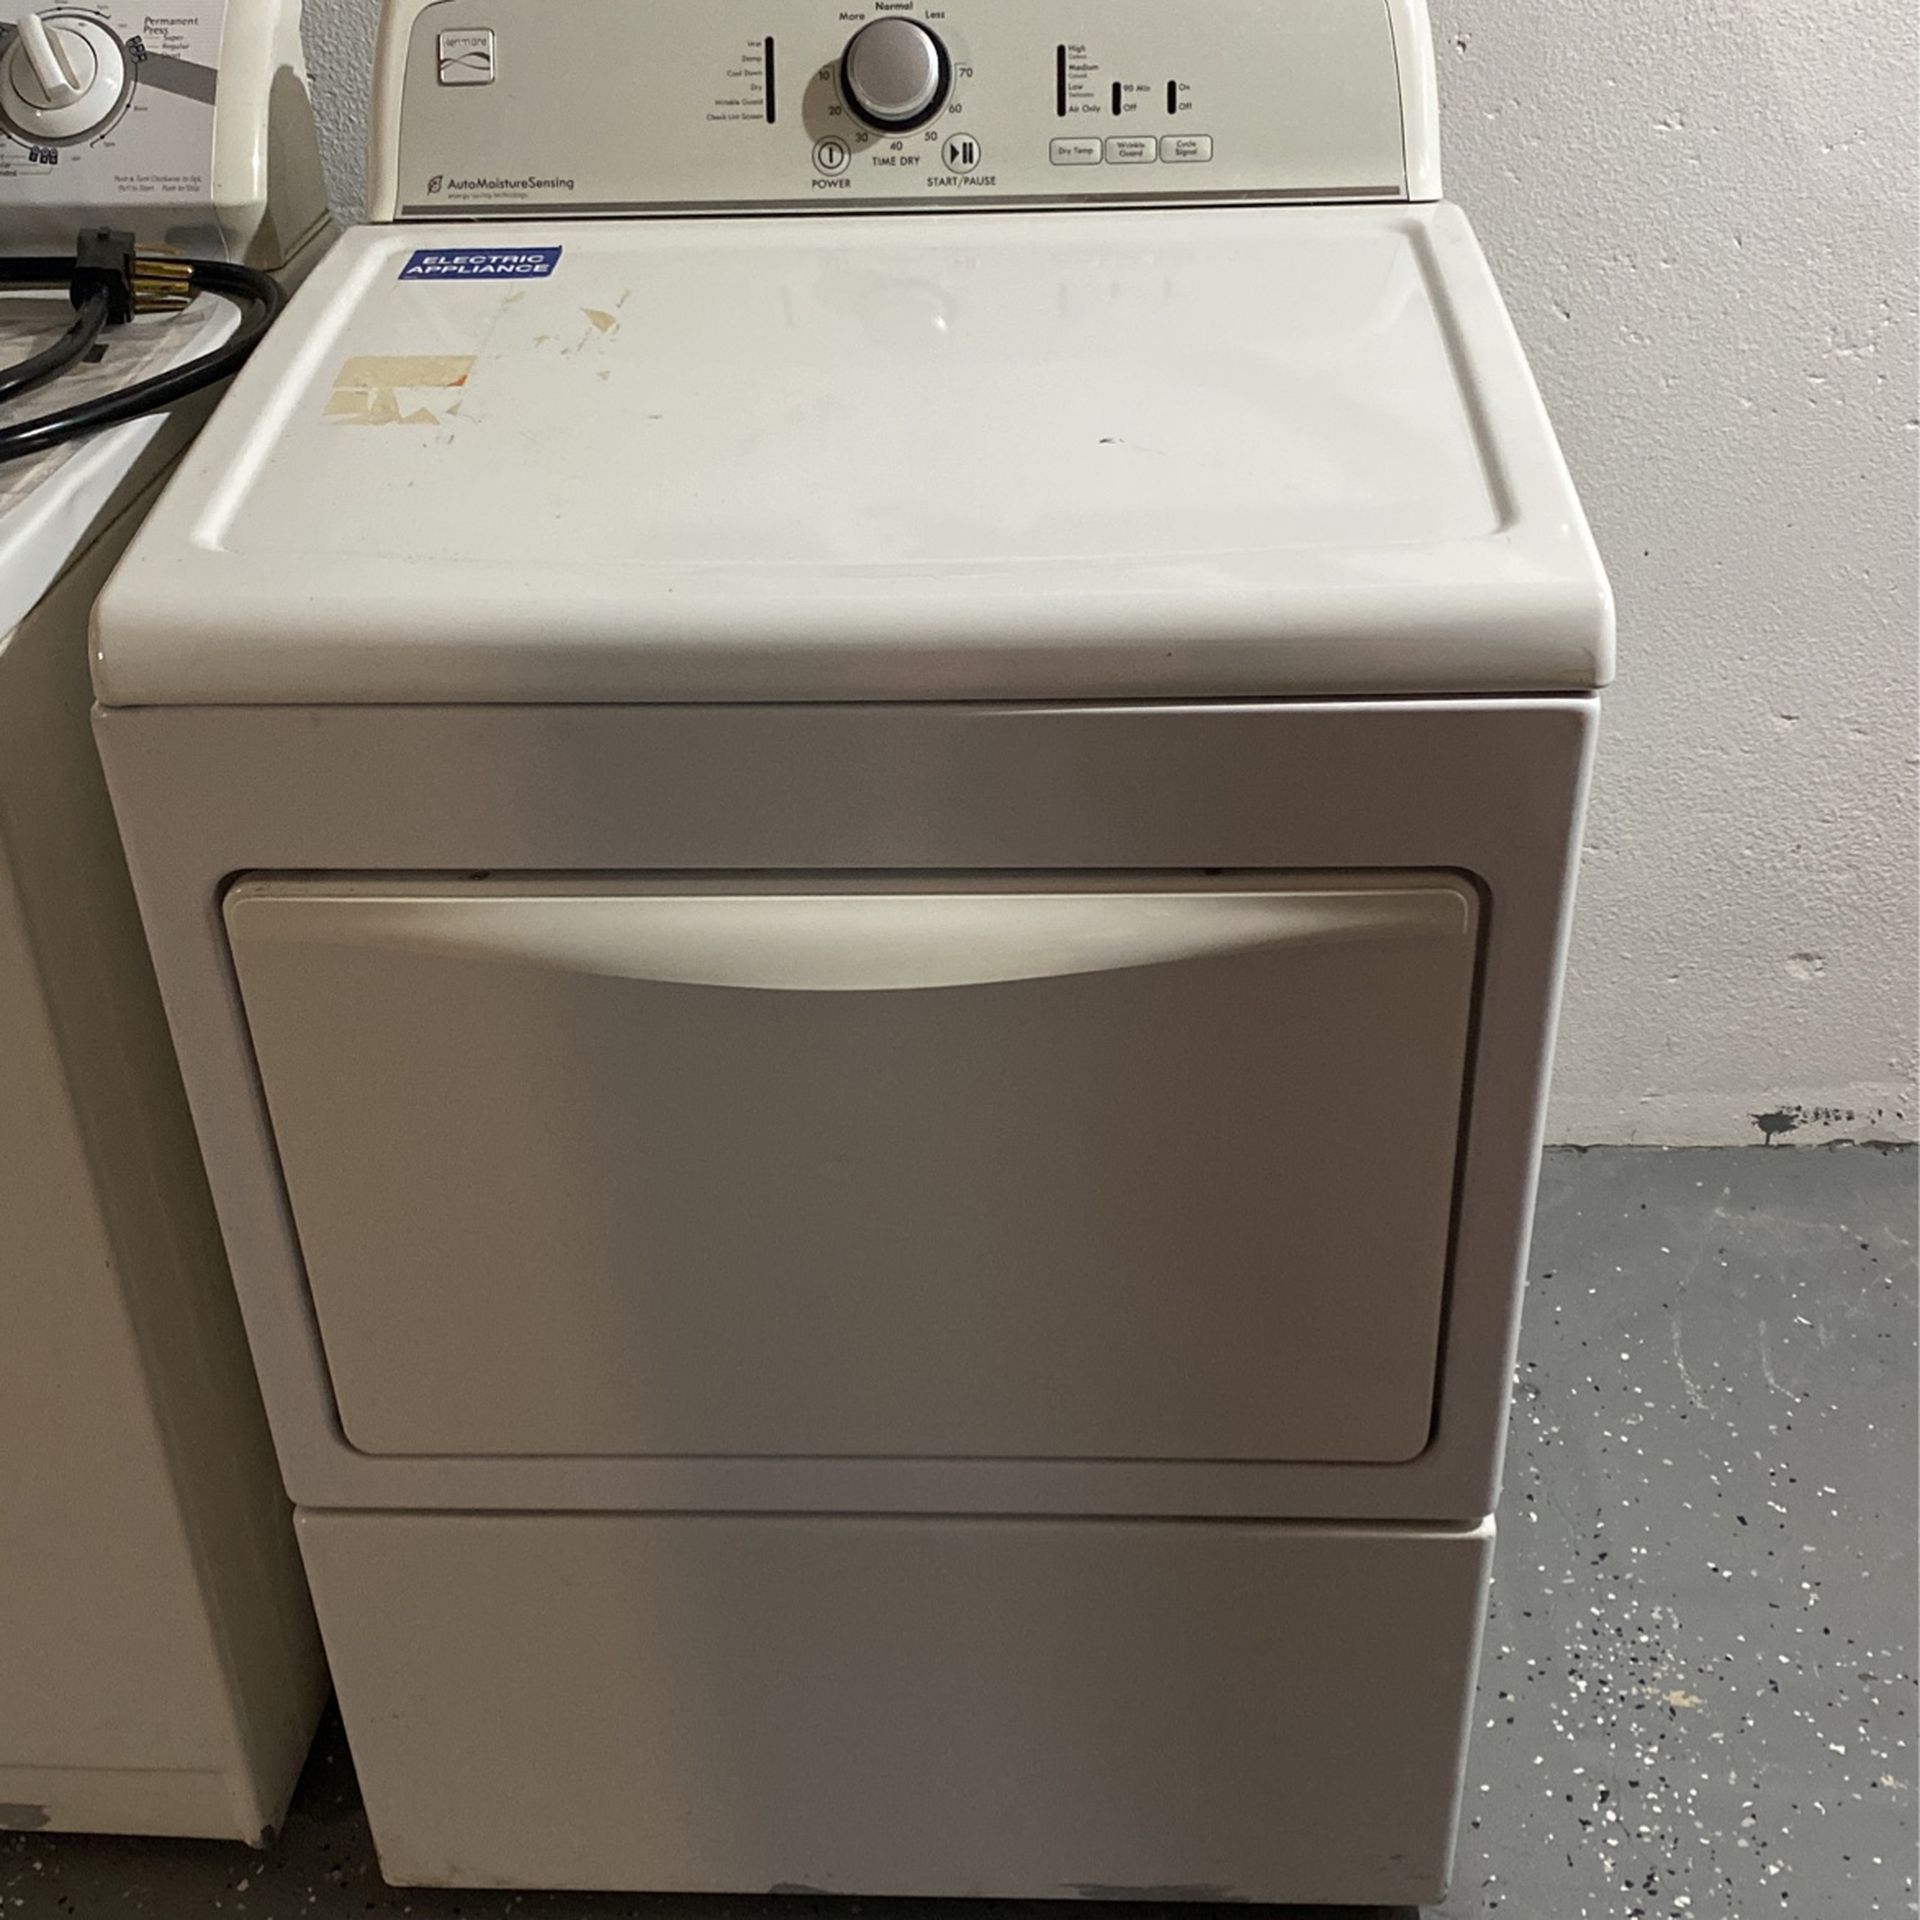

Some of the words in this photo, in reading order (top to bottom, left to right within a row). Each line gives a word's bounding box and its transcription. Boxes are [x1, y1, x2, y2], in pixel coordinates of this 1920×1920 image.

[875, 1, 914, 11] Normal
[839, 12, 865, 21] More
[925, 10, 946, 19] Less
[144, 16, 199, 26] Permanent
[143, 25, 169, 35] Press
[1068, 44, 1086, 53] High
[959, 67, 973, 77] 70
[1068, 63, 1099, 71] Medium
[818, 70, 830, 80] 10
[1068, 83, 1083, 91] Low
[1123, 84, 1134, 92] 90
[1179, 83, 1190, 92] On
[828, 106, 842, 116] 20
[949, 104, 962, 114] 60
[1081, 103, 1101, 113] Only
[1123, 103, 1137, 112] Off
[1179, 102, 1192, 111] Off
[855, 133, 869, 143] 30
[924, 131, 938, 142] 50
[890, 141, 903, 151] 40
[1176, 140, 1197, 149] Cycle
[1058, 147, 1072, 156] Dry
[1074, 146, 1094, 155] Temp
[1119, 149, 1143, 157] Guard
[1175, 148, 1198, 156] Signal
[872, 156, 897, 167] TIME
[900, 156, 920, 166] DRY
[448, 176, 575, 190] AutoMoistureSensing
[811, 179, 851, 189] POWER
[927, 176, 996, 188] START/PAUSE
[422, 254, 545, 265] ELECTRIC
[405, 264, 550, 274] APPLIANCE
